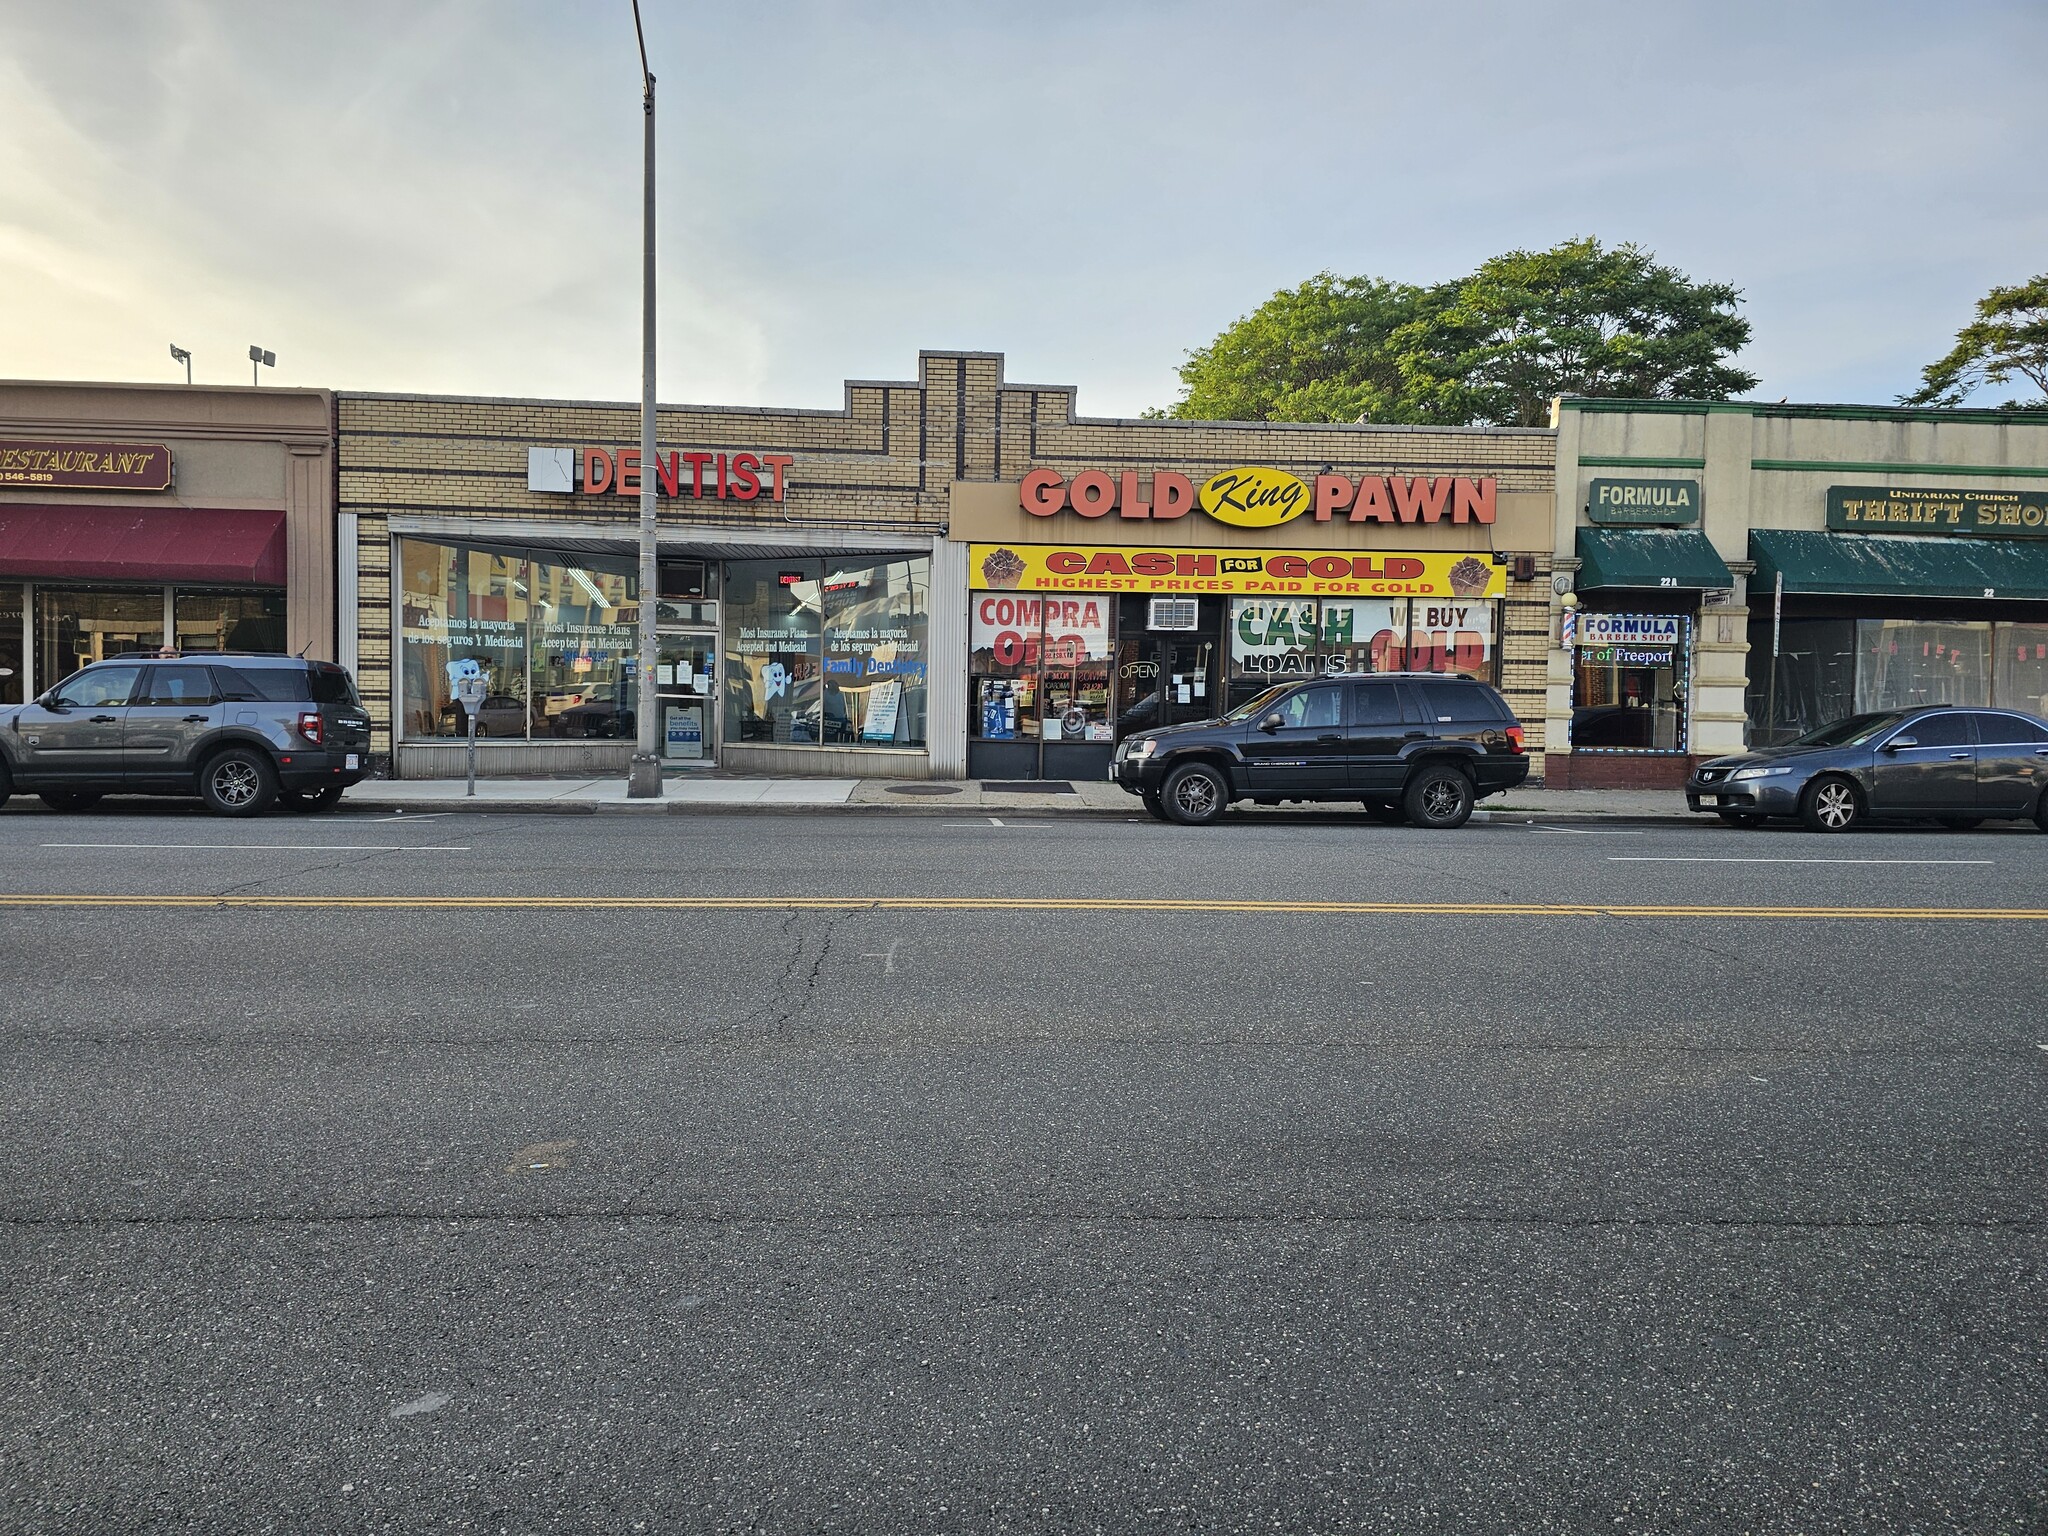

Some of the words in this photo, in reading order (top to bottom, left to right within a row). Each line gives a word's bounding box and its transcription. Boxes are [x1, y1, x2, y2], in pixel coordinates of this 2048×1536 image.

[0, 448, 154, 474] ESTAURANT
[5, 472, 53, 482] 546-5819
[583, 448, 794, 501] DENTIST
[1020, 468, 1195, 520] GOLD
[1211, 474, 1304, 518] King
[1315, 475, 1497, 524] PAWN
[1599, 485, 1690, 506] FORMULA
[1890, 490, 1960, 500] UNITARIAN
[1965, 492, 2018, 501] CHURCH
[1610, 506, 1650, 515] BARBER
[1652, 506, 1677, 516] SHOP
[1843, 499, 1964, 524] THRIFT
[1046, 552, 1217, 577] CASH
[1225, 559, 1258, 570] FOR
[1265, 556, 1425, 579] GOLD
[1036, 577, 1139, 589] HIGHEST
[1150, 579, 1234, 591] PRICES
[1245, 580, 1302, 591] PAID
[1313, 582, 1360, 593] FOR
[1371, 583, 1434, 593] GOLD
[1983, 588, 1995, 598] 22
[980, 598, 1101, 629] COMPRA
[1389, 606, 1420, 627] WE
[1427, 607, 1468, 627] BUY
[418, 614, 467, 631] Aceptamos
[469, 616, 478, 629] la
[544, 621, 564, 634] Most
[566, 622, 606, 634] Insurance
[608, 623, 631, 636] Plans
[1585, 619, 1676, 634] FORMULA
[408, 632, 419, 644] de
[421, 632, 434, 645] los
[437, 635, 474, 648] seguros
[475, 634, 482, 646] Y
[485, 635, 524, 648] Medicaid
[739, 627, 756, 639] Most
[757, 627, 788, 639] Insurance
[789, 627, 808, 639] Plans
[834, 627, 870, 641] Aceptamos
[871, 627, 878, 639] la
[1590, 633, 1637, 641] BARBER
[1642, 634, 1672, 642] SHOP
[541, 637, 579, 652] Accepted
[580, 638, 597, 649] and
[598, 638, 633, 650] Medicaid
[736, 641, 764, 654] Accepted
[765, 641, 778, 652] and
[778, 641, 807, 653] Medicaid
[831, 641, 839, 652] de
[840, 641, 850, 652] los
[852, 642, 878, 655] seguros
[887, 640, 919, 652] Medicaid
[993, 630, 1086, 668] ORO
[1242, 653, 1347, 675] LOANS
[1596, 648, 1614, 661] of
[1615, 648, 1673, 665] Freeport
[823, 657, 864, 678] Family
[868, 657, 927, 679] Dentistry
[1120, 663, 1158, 679] OPEN
